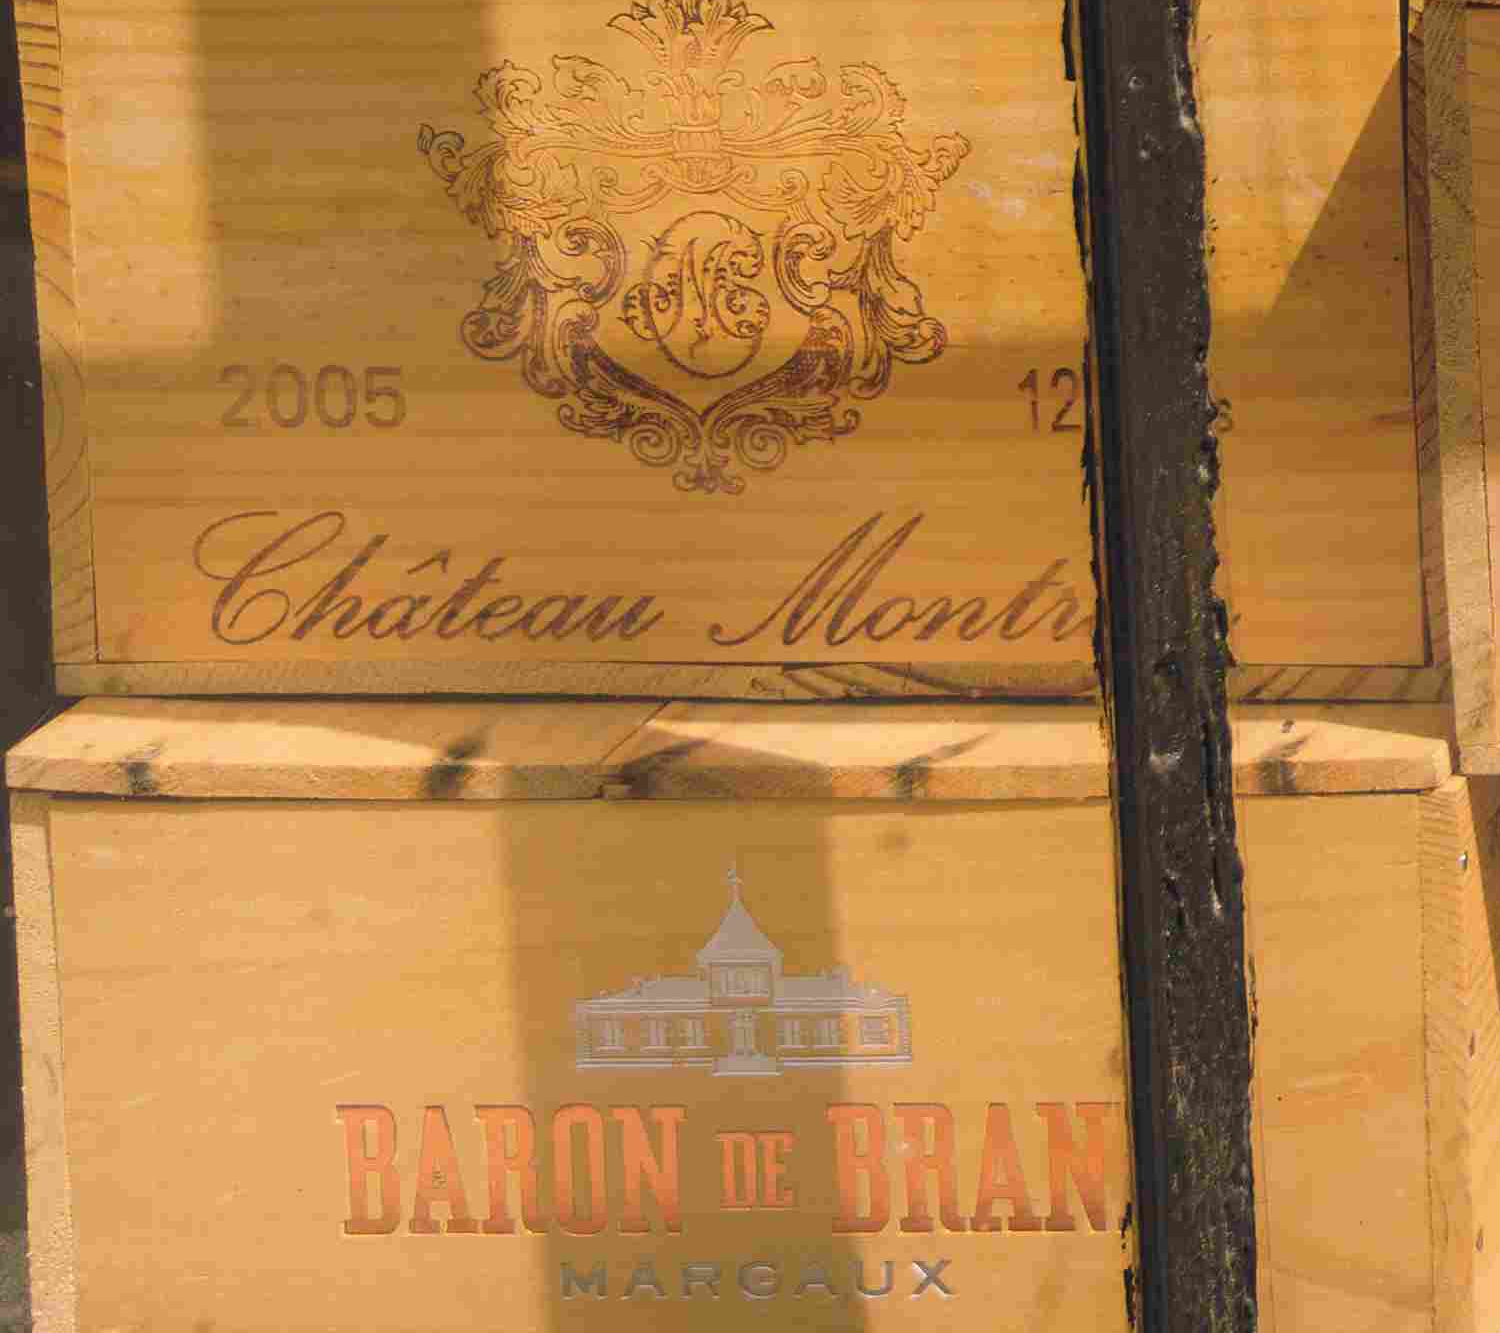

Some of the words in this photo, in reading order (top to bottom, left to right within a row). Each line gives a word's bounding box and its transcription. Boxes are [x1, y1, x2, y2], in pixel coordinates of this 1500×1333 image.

[218, 362, 408, 432] 2005
[1017, 366, 1082, 434] 12
[192, 510, 664, 647] Château
[708, 510, 1098, 647] Montr
[336, 1101, 688, 1238] BARON
[716, 1129, 794, 1211] DE
[829, 1099, 1121, 1237] BRAN
[560, 1257, 956, 1301] MARGAUX
